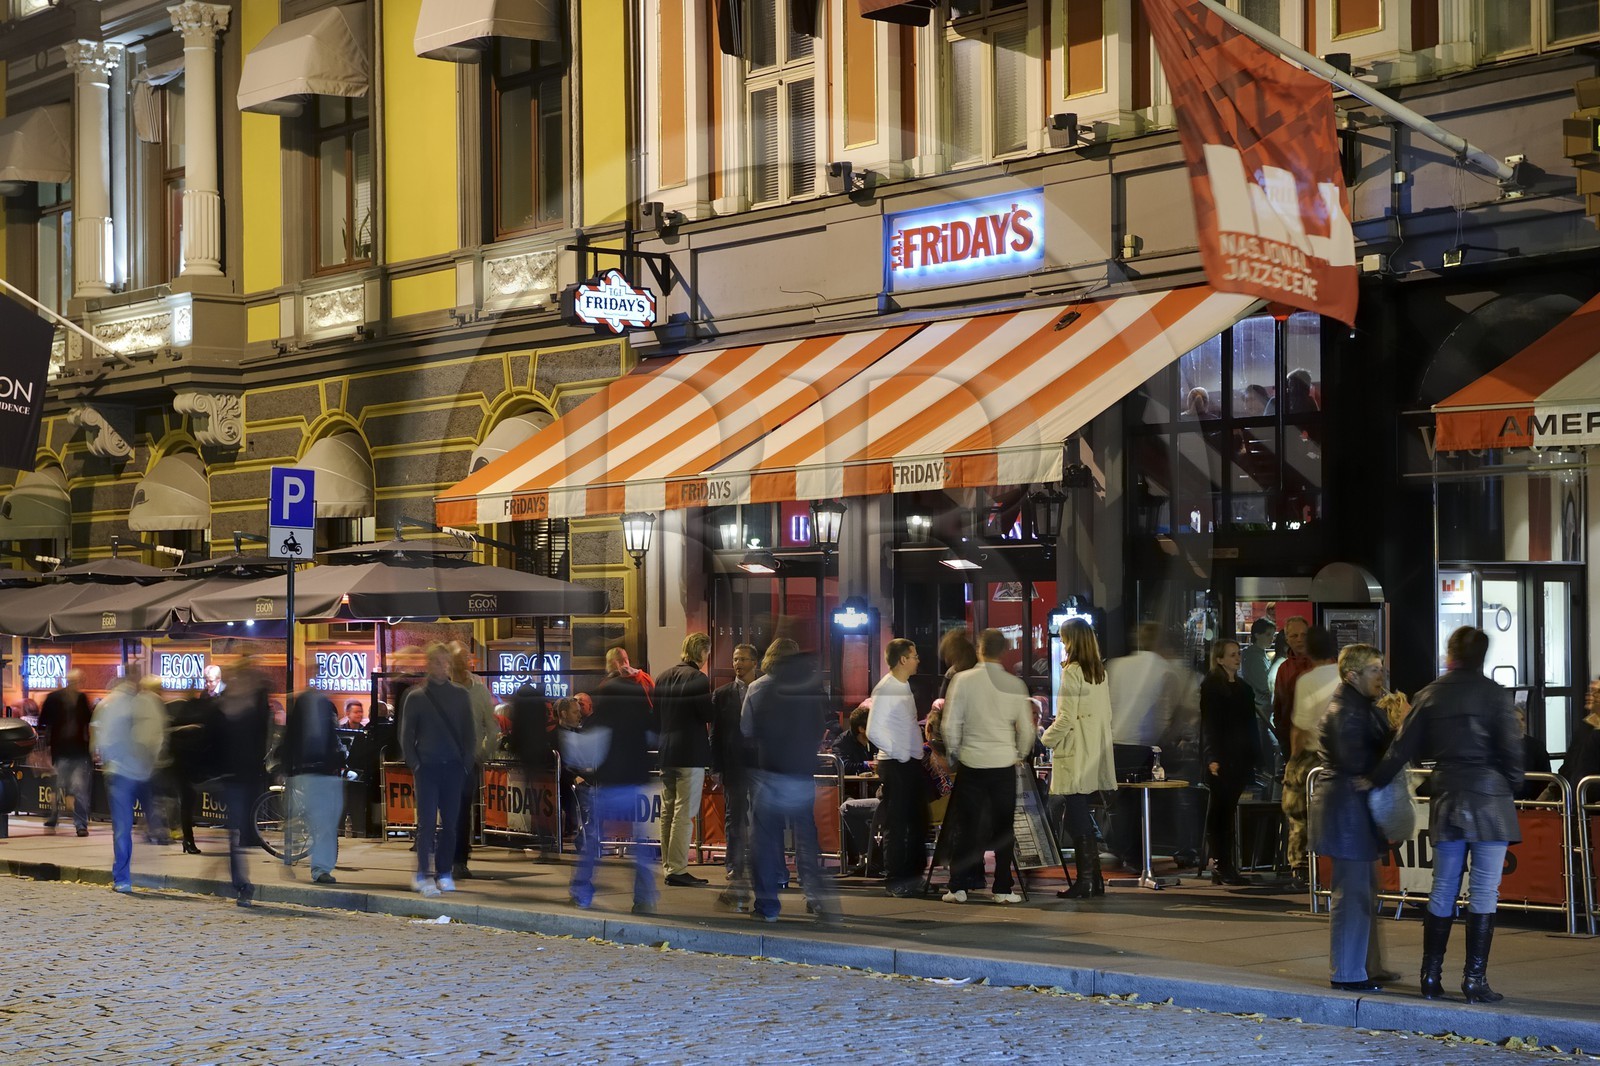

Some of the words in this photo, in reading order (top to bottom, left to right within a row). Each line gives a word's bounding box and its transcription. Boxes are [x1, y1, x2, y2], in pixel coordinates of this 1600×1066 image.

[904, 204, 1034, 269] FRiDAY'S
[1222, 258, 1318, 300] JAZZSCENE
[586, 296, 645, 313] FRIDAY'S
[282, 476, 306, 520] P
[256, 603, 273, 613] EGON
[468, 599, 497, 609] EGON
[102, 616, 116, 626] EGON
[28, 655, 67, 678] EGON
[161, 653, 205, 678] EGON
[315, 652, 367, 679] EGON
